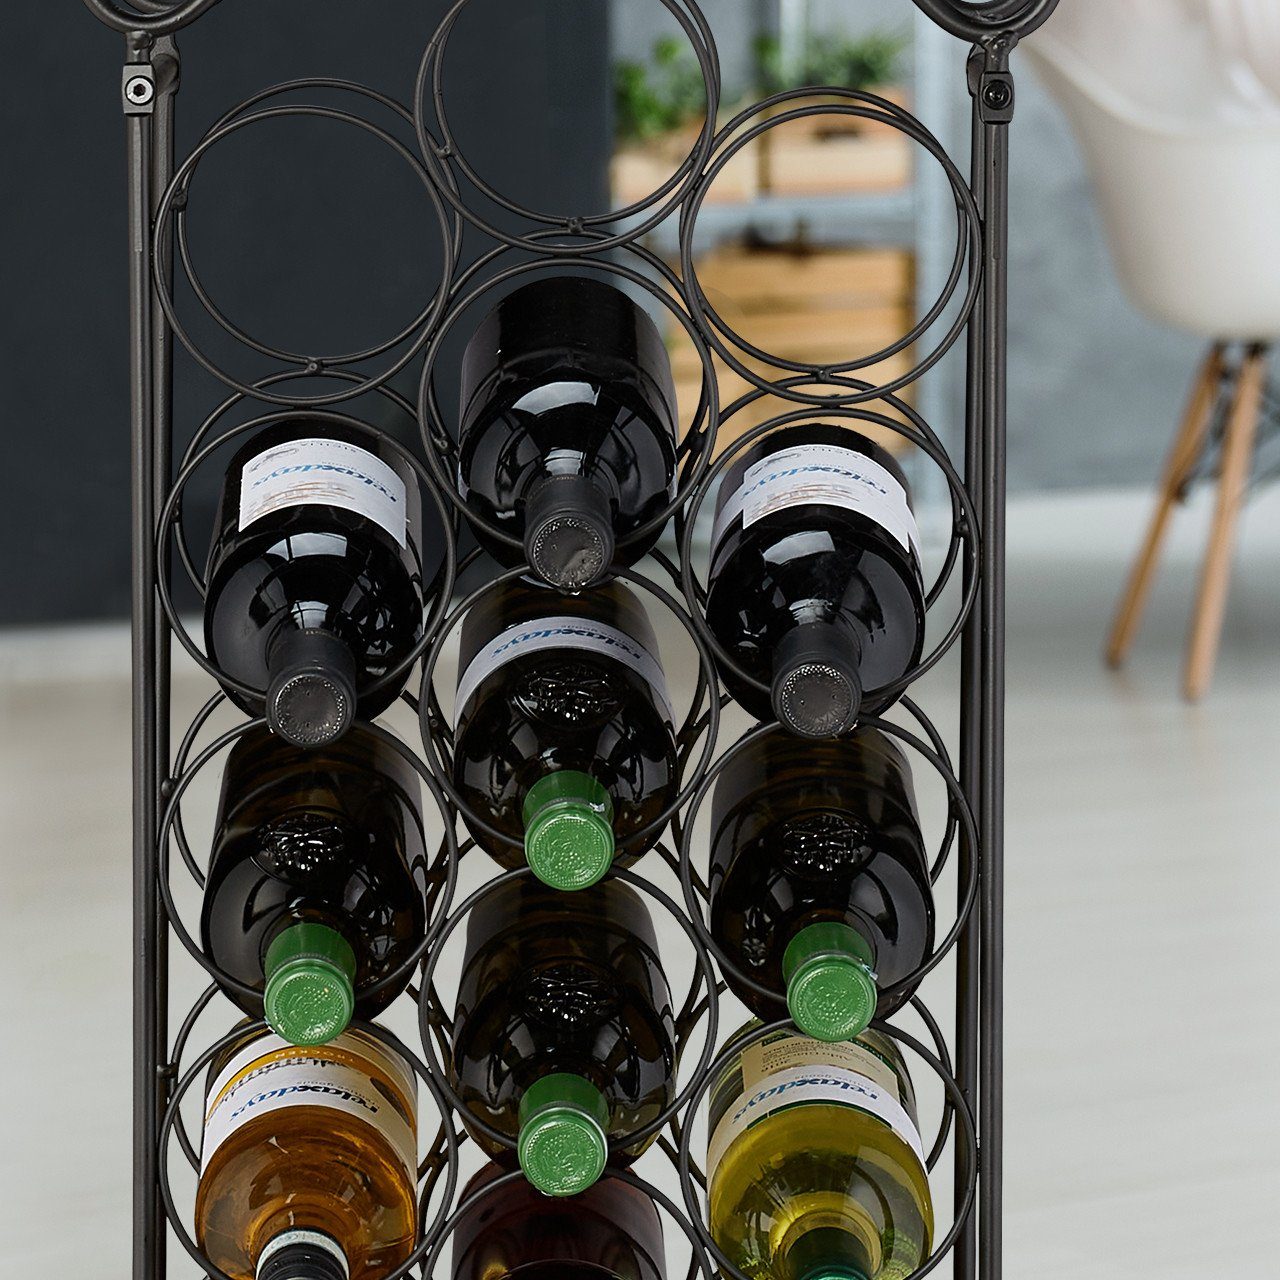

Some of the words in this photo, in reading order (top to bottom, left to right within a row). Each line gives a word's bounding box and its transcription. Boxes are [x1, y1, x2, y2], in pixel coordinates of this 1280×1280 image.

[251, 464, 398, 504] relaxdays
[740, 466, 888, 501] relaxdays
[490, 628, 643, 661] relaxdays
[227, 1085, 380, 1123] relaxdays
[732, 1077, 879, 1124] relaxdays
